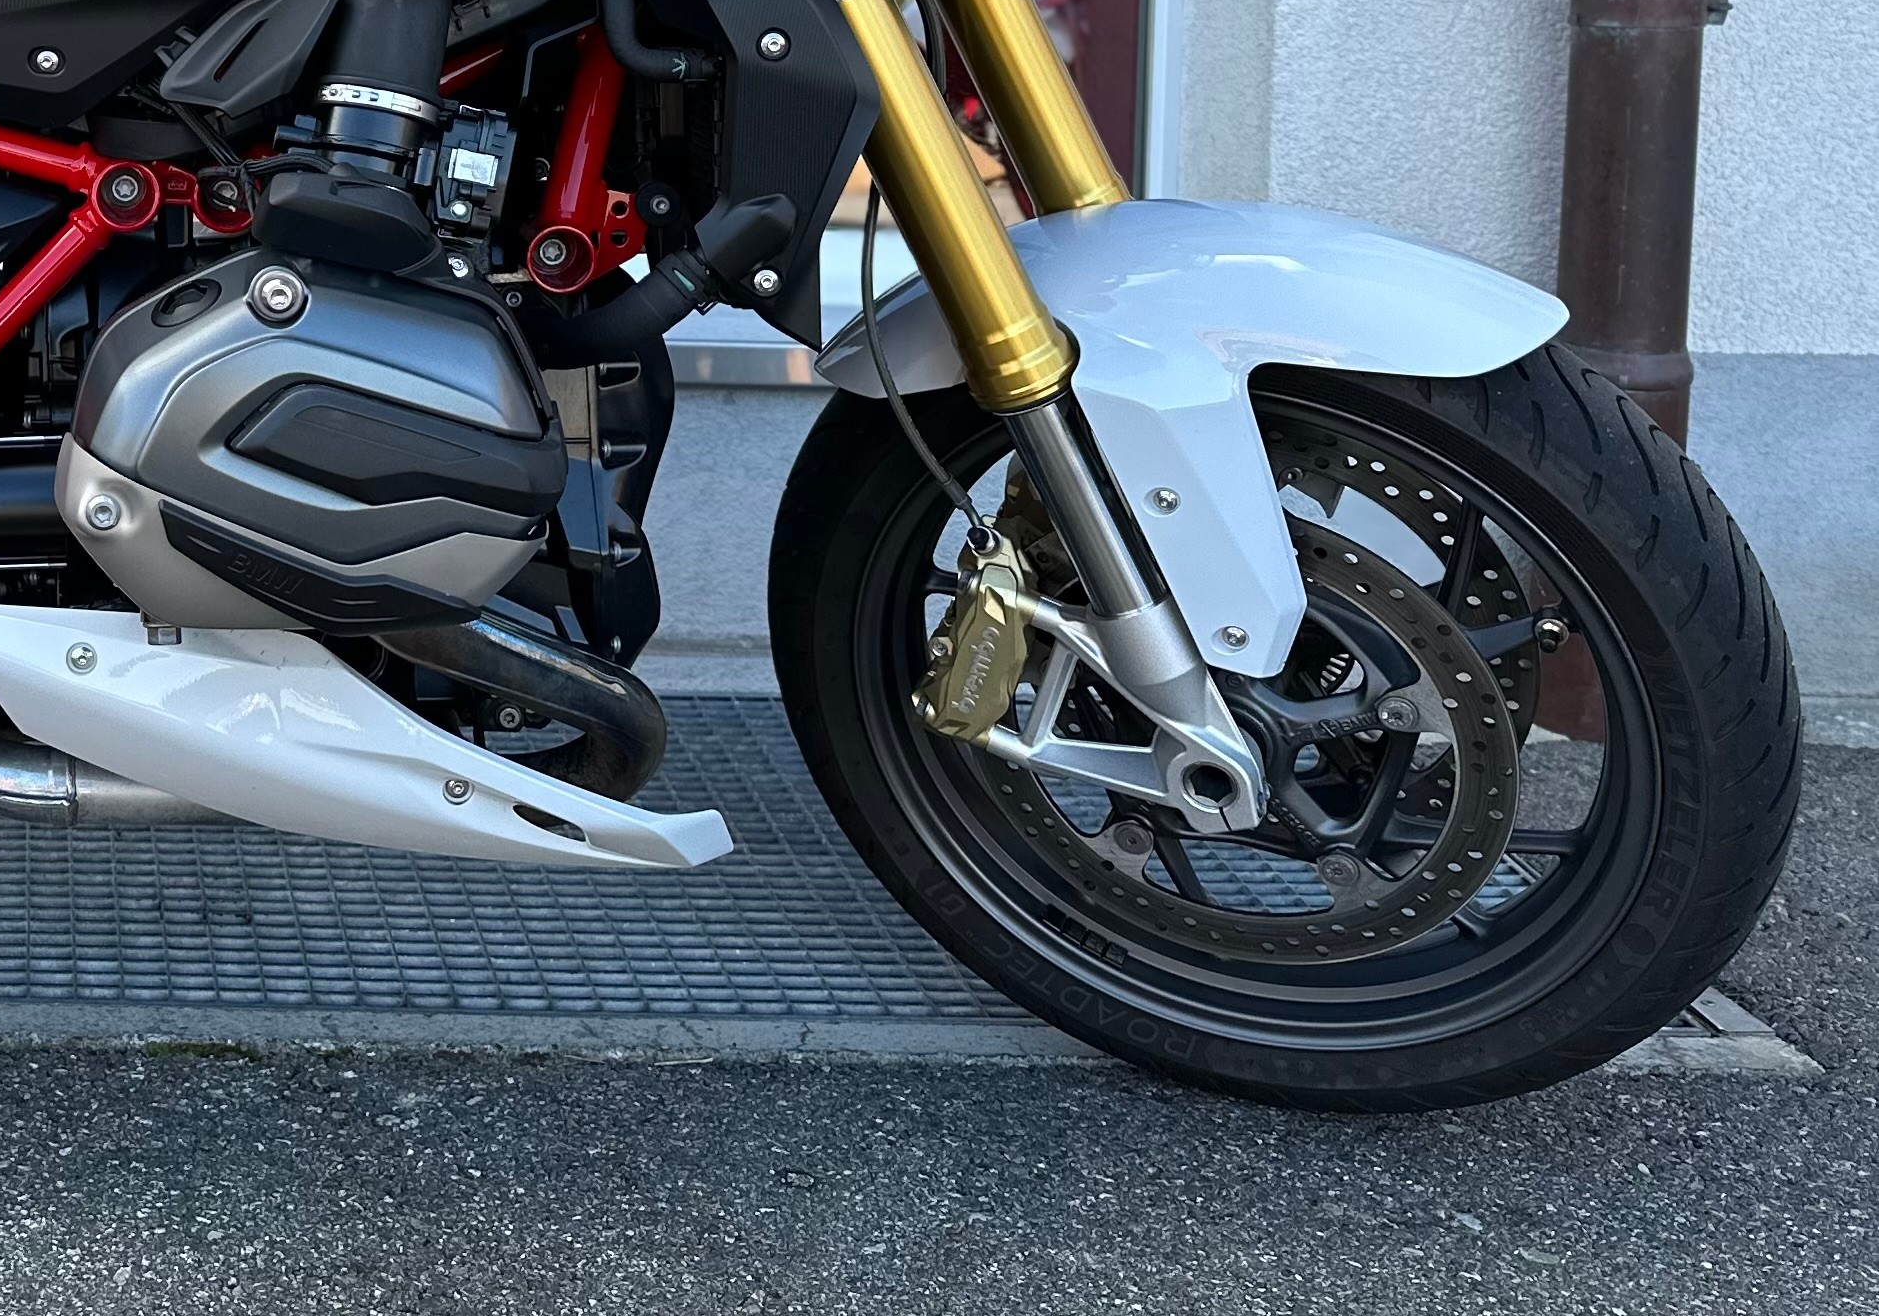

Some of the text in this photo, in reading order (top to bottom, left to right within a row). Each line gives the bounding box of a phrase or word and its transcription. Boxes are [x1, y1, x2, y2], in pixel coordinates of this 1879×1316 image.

[226, 553, 305, 594] BMW
[950, 625, 1001, 716] brembo
[1642, 654, 1702, 918] METZELER
[983, 933, 1197, 1060] ROADTEC
